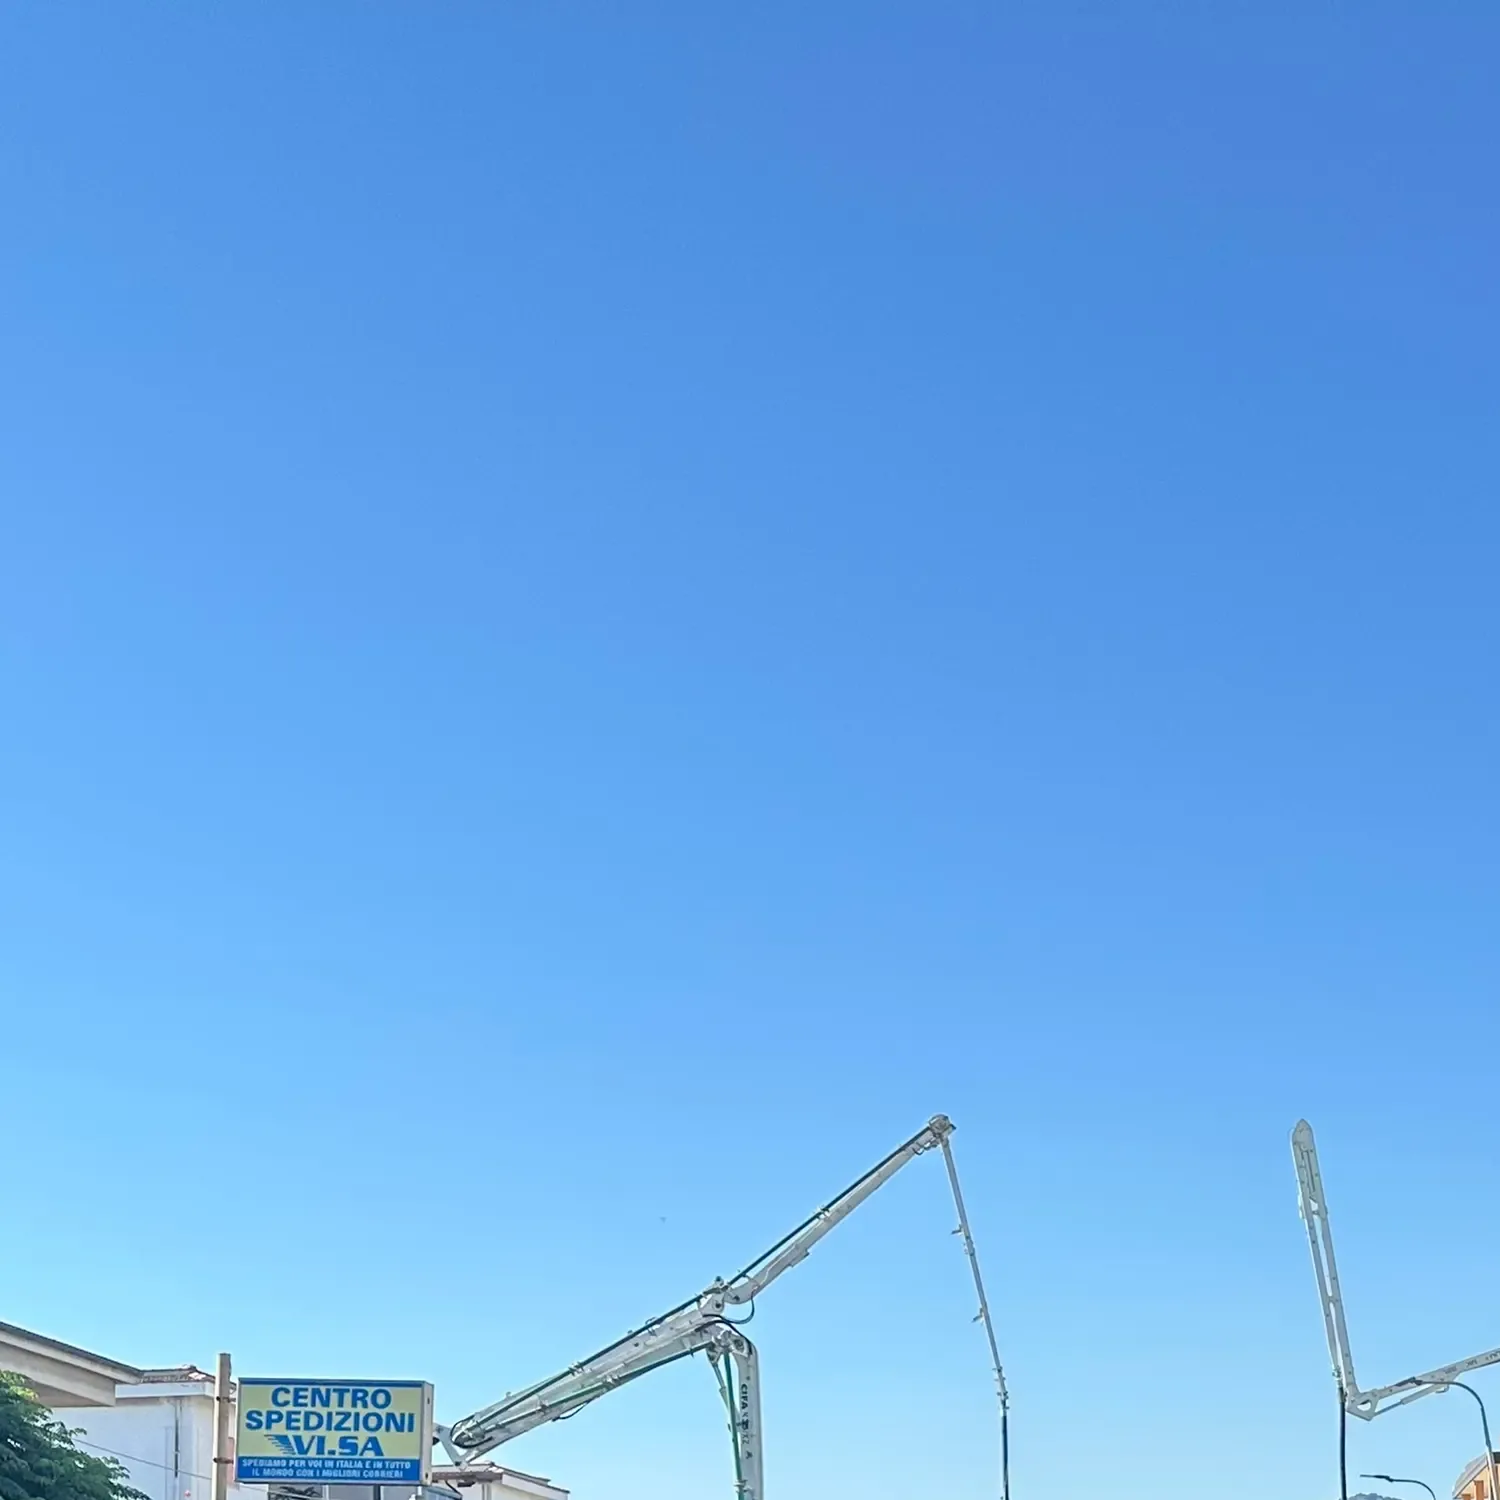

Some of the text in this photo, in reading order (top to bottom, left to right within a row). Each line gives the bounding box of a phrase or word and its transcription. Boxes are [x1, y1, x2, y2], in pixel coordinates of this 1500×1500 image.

[271, 1387, 392, 1409] CENTRO
[245, 1410, 415, 1432] SPEDIZIONI
[242, 1459, 287, 1467] SPEDIAMO
[324, 1460, 334, 1468] IN
[336, 1460, 363, 1468] ITALIA
[385, 1461, 411, 1469] TUTTO
[263, 1469, 294, 1477] MONDO
[296, 1469, 314, 1477] CON
[322, 1469, 361, 1477] MIGLIORI
